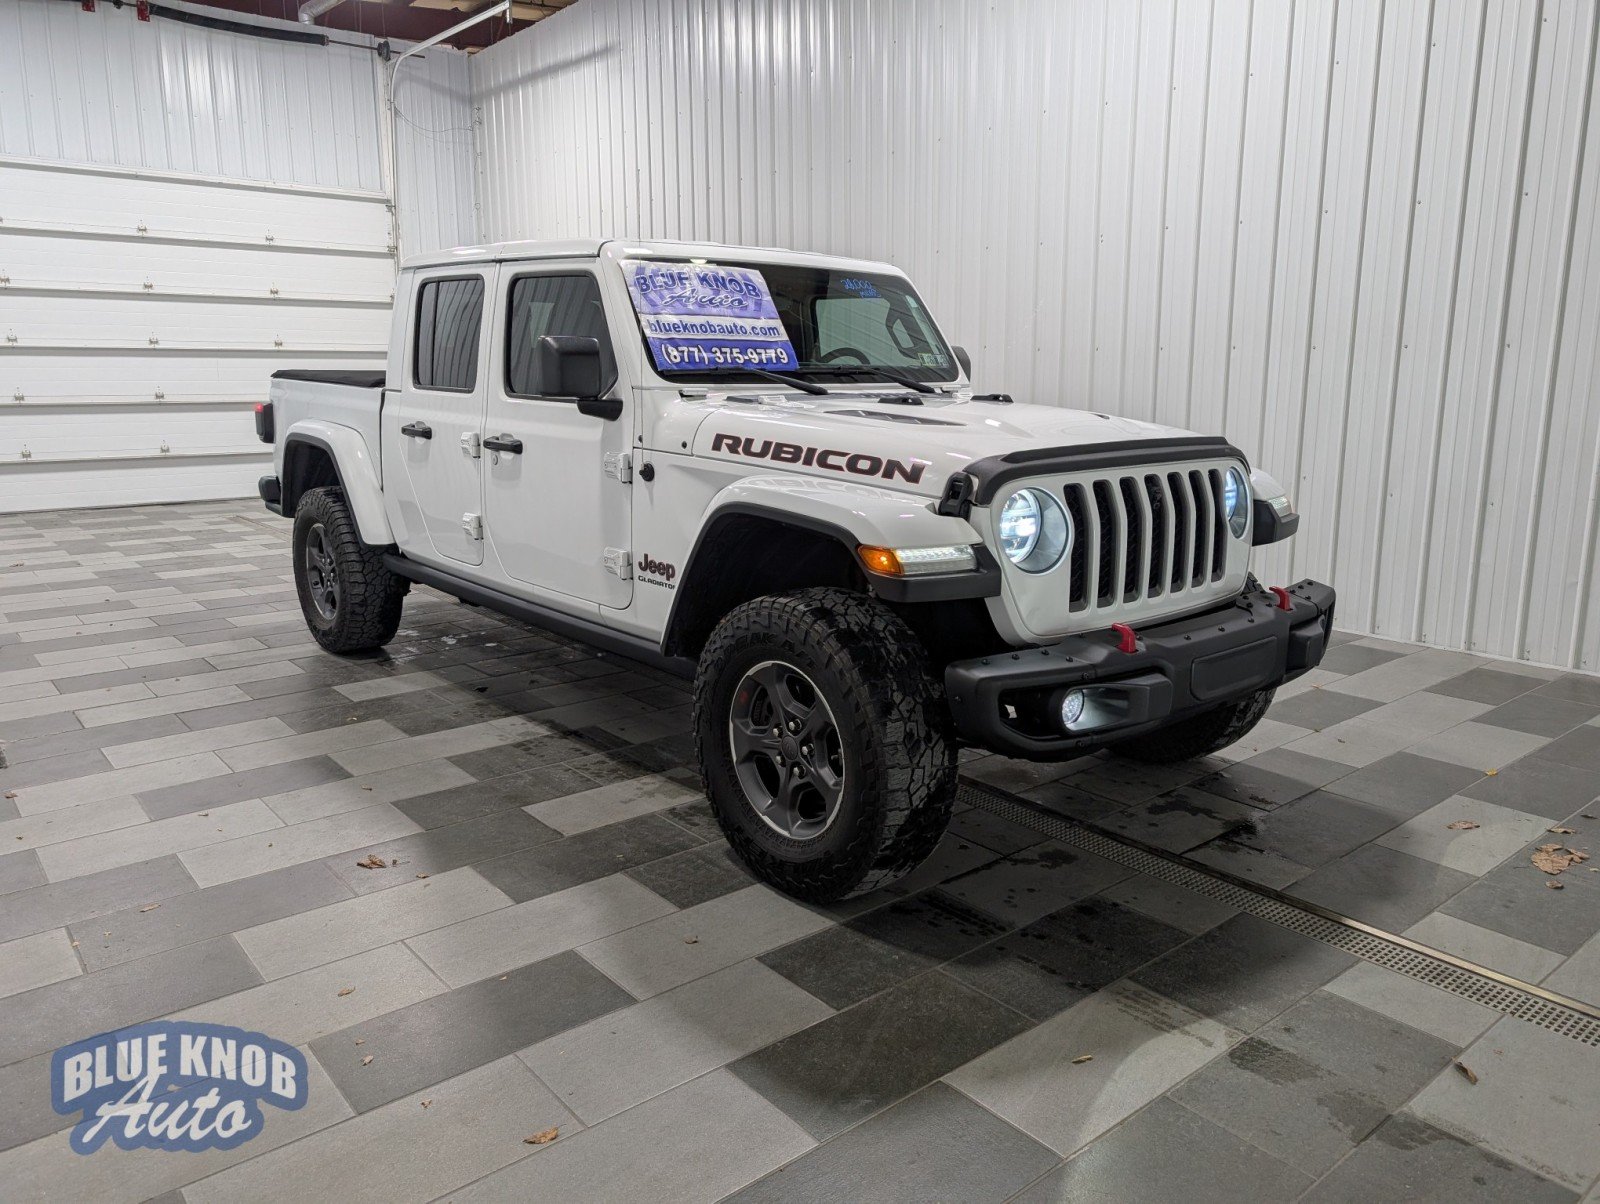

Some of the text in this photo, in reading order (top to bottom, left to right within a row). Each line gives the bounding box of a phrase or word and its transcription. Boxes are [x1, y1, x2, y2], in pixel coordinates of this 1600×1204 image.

[635, 271, 762, 299] BLUE KNOB
[661, 287, 749, 308] Auto
[647, 319, 781, 337] blueknobauto.com
[661, 344, 789, 365] (877) 375-9779
[711, 433, 926, 485] RUBICON
[637, 553, 676, 581] Jeep
